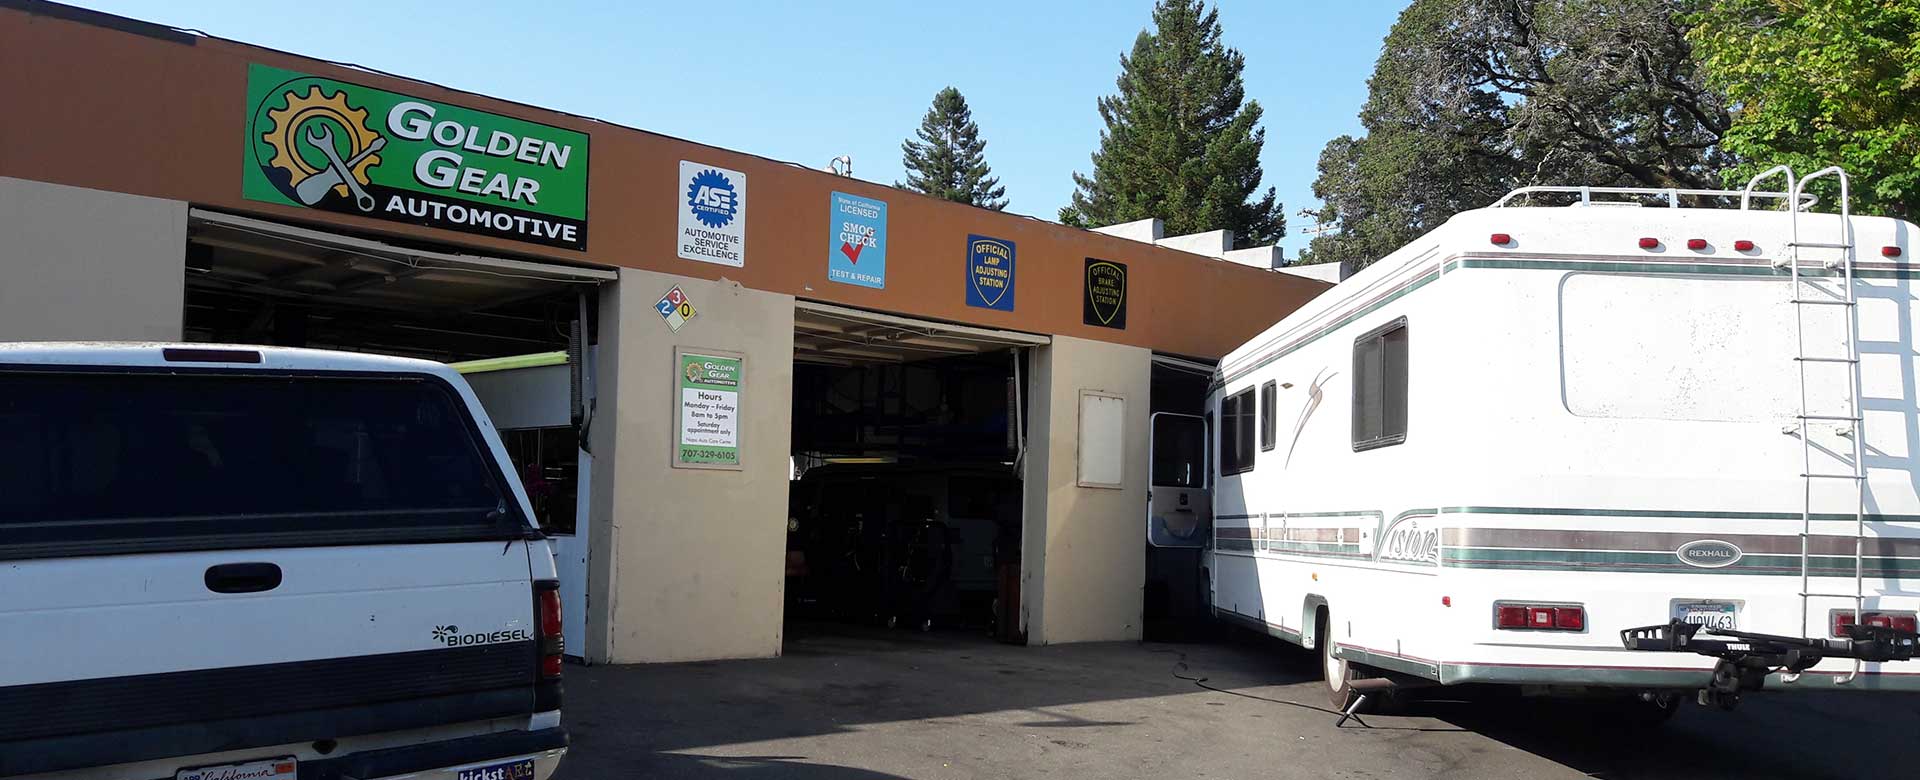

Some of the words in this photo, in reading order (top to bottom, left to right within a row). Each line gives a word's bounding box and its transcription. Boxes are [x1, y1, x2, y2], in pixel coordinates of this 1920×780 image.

[386, 101, 572, 170] GOLDEN
[413, 149, 541, 206] GEAR
[694, 185, 731, 209] ASE
[696, 204, 730, 216] CERTIFIED
[840, 203, 878, 219] LICENSED
[385, 195, 578, 243] AUTOMOTIVE
[684, 227, 739, 244] AUTOMOTIVE
[843, 222, 874, 237] SMOG
[694, 237, 729, 251] SERVICE
[840, 232, 877, 248] CHECK
[683, 244, 739, 261] EXCELLENCE
[976, 244, 1009, 260] OFFICIAL
[984, 256, 1000, 266] LAMP
[832, 269, 849, 278] TEST
[850, 272, 856, 280] &
[857, 272, 882, 284] REPAIR
[975, 265, 1008, 279] ADJUSTING
[1093, 266, 1121, 281] OFFICIAL
[979, 277, 1004, 288] STATION
[1098, 277, 1115, 287] BRAKE
[672, 290, 681, 305] 3
[1093, 286, 1120, 297] ADJUSTING
[661, 300, 671, 314] 2
[1095, 295, 1117, 305] STATION
[681, 303, 690, 317] 0
[704, 361, 736, 371] GOLDEN
[708, 370, 730, 378] GEAR
[697, 391, 722, 401] Hours
[684, 401, 710, 411] Monday
[716, 403, 735, 413] Friday
[707, 411, 713, 419] to
[714, 412, 729, 420] 5pm
[697, 420, 720, 429] Saturday
[682, 449, 736, 460] 707-329-6105
[1688, 549, 1731, 557] REXHALL
[447, 629, 529, 647] BIODIESEL
[1726, 643, 1751, 651] THULE
[204, 768, 274, 780] California
